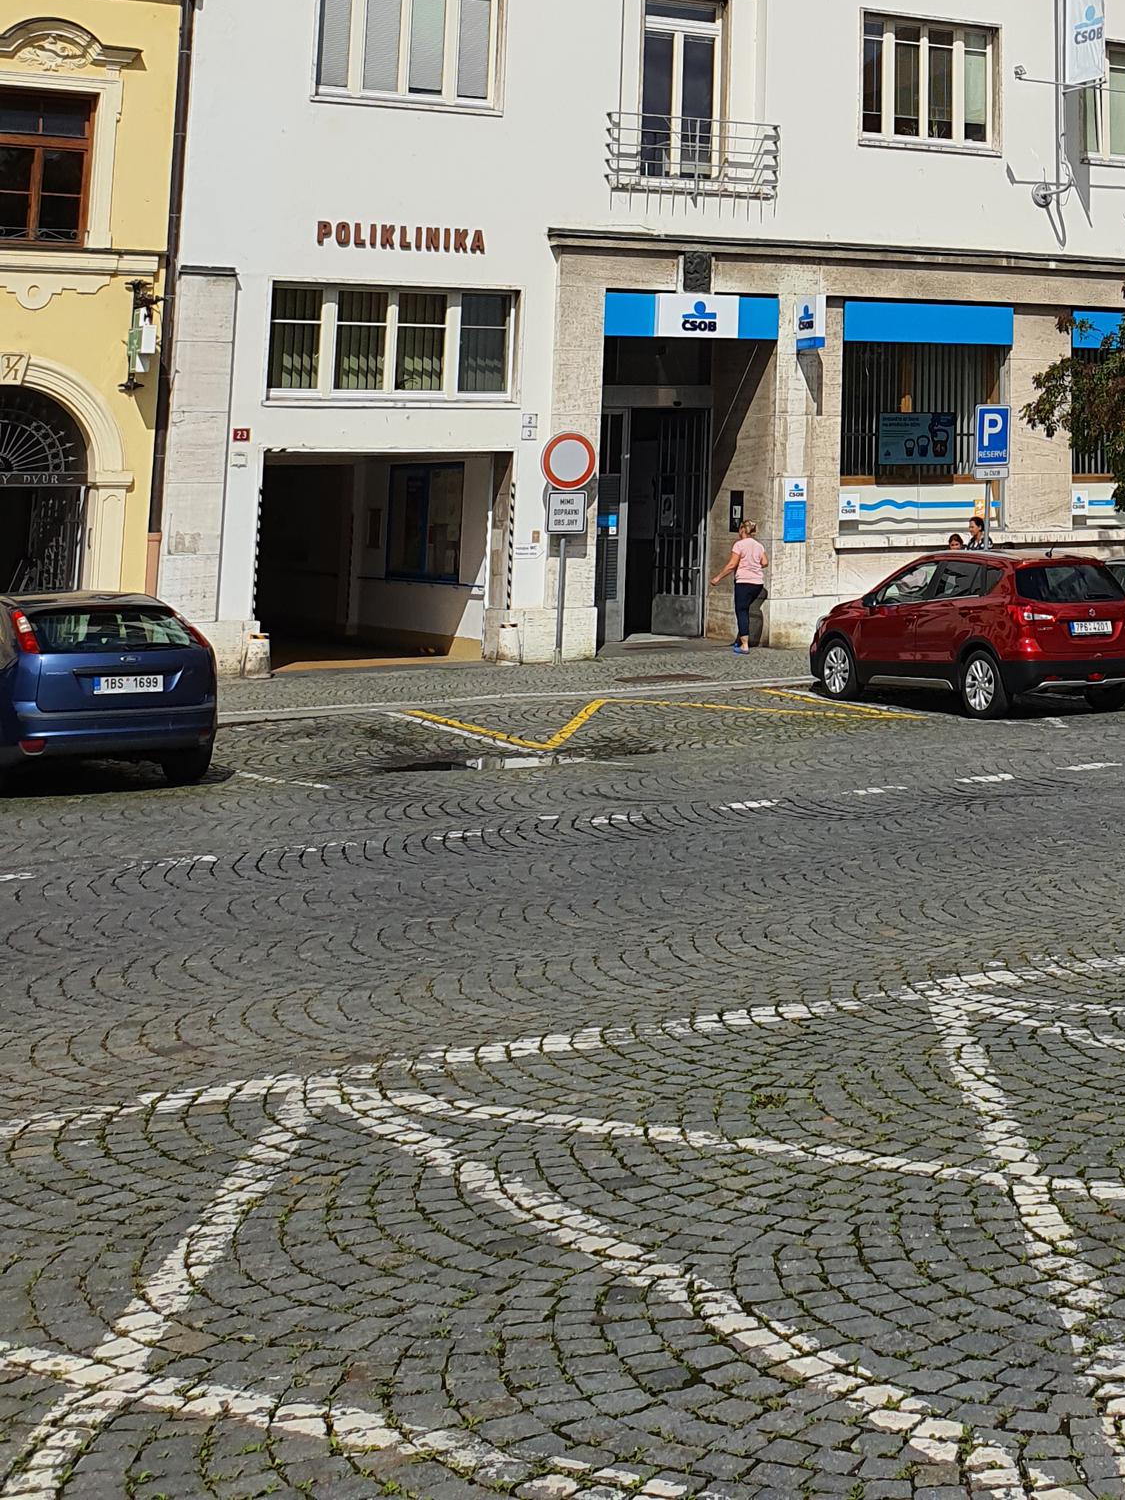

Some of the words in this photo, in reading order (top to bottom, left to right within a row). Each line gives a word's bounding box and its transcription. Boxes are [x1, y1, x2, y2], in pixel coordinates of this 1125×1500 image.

[1074, 27, 1103, 44] ČSOB
[316, 220, 486, 255] POLIKLINIKA
[681, 319, 717, 332] ČSOB
[798, 320, 814, 331] ČSOB
[236, 430, 248, 439] 23
[527, 430, 532, 438] 3
[983, 413, 1003, 447] P
[104, 679, 124, 689] 1BS
[133, 677, 159, 688] 1699
